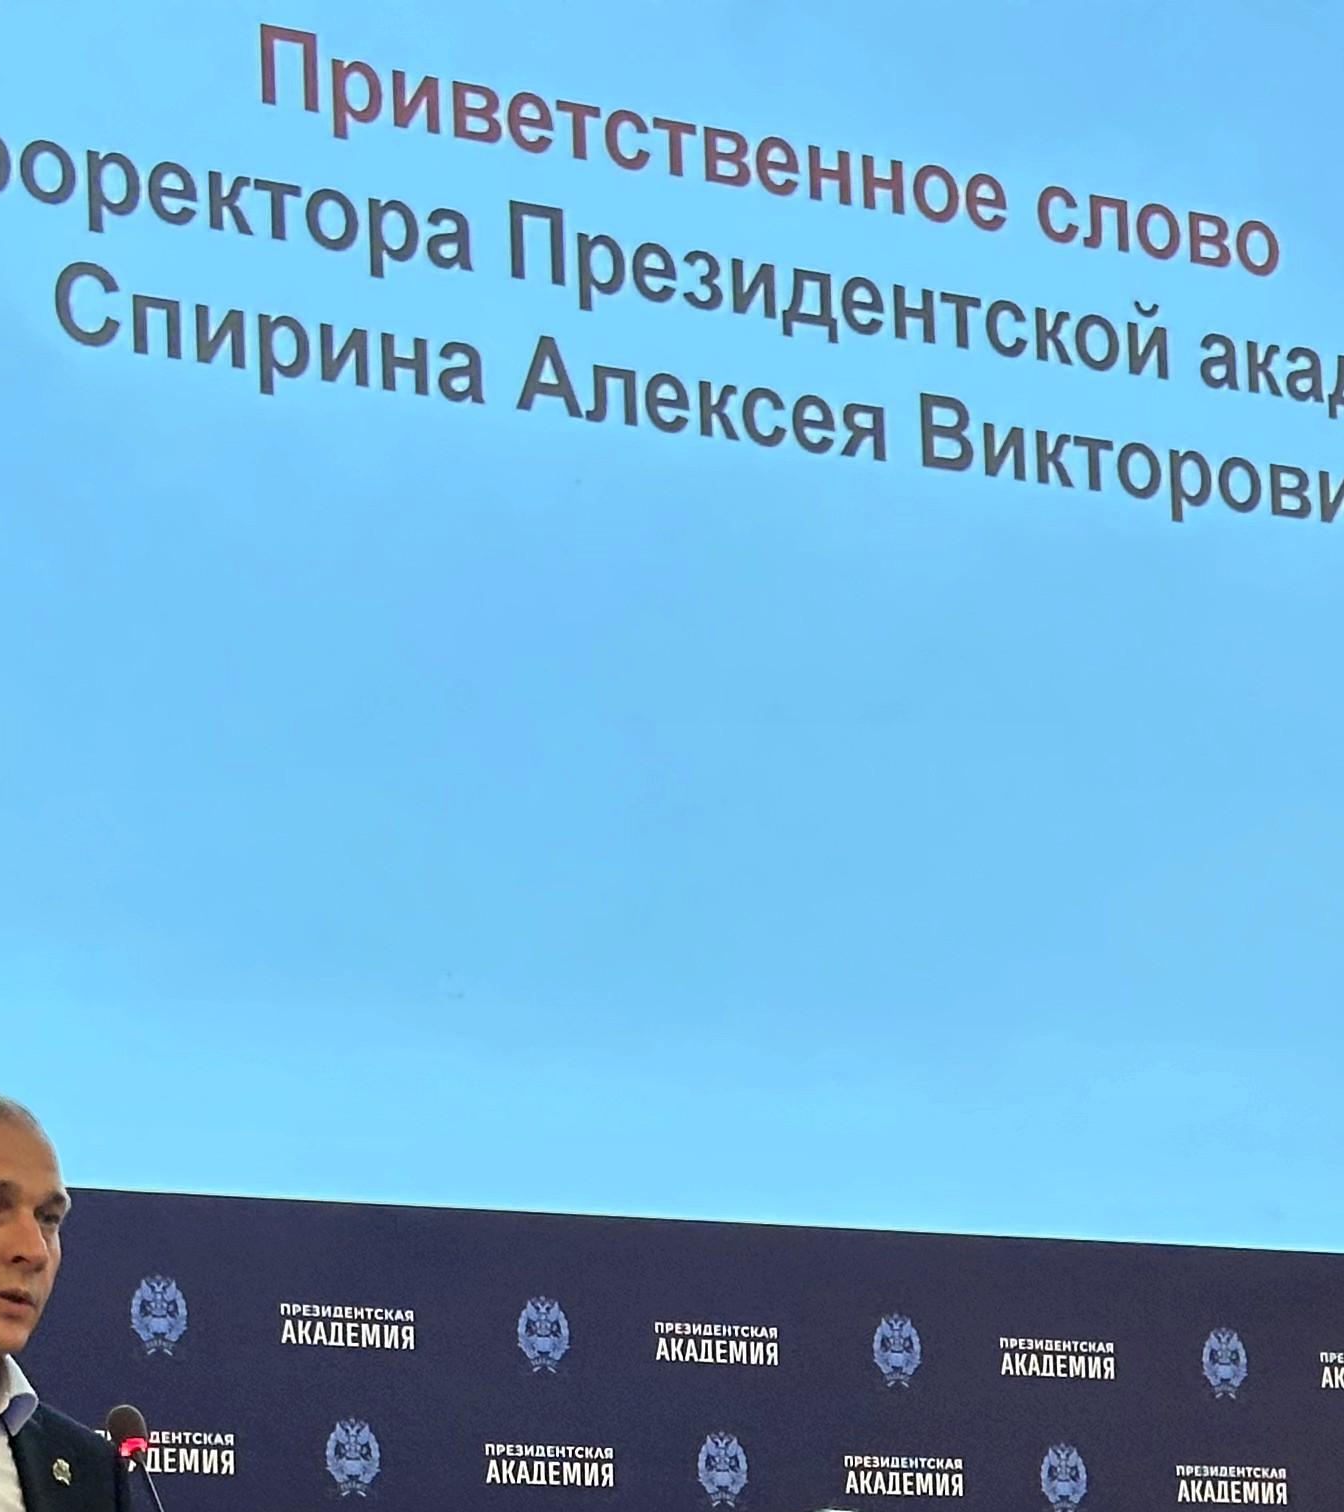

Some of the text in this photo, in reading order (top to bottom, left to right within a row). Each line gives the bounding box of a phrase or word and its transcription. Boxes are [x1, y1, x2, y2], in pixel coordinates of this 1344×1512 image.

[259, 22, 1281, 278] Приветственное слово
[508, 199, 1169, 380] Президентской
[54, 261, 485, 405] Спирина
[515, 334, 886, 462] Алексея
[281, 1304, 413, 1321] ПРЕЗИДЕНТСКАЯ
[282, 1320, 414, 1349] АКАДЕМИЯ
[655, 1322, 777, 1339] ПРЕЗИДЕНТСКАЯ
[656, 1338, 778, 1365] АКАДЕМИЯ
[1000, 1337, 1113, 1353] ПРЕЗИДЕНТСКАЯ
[1001, 1353, 1114, 1379] АКАДЕМИЯ
[94, 1430, 234, 1446] ДЕНТСКАЯ
[128, 1447, 235, 1475] ДЕМИЯ
[485, 1444, 613, 1459] ПРЕЗИДЕНТСКАЯ
[845, 1456, 962, 1469] ПРЕЗИДЕНТСКАЯ
[486, 1459, 613, 1487] АКАДЕМИЯ
[846, 1471, 963, 1496] АКАДЕМИЯ
[1176, 1465, 1286, 1479] ПРЕЗИДЕНТСКАЯ
[1178, 1480, 1287, 1504] АКАДЕМИЯ
